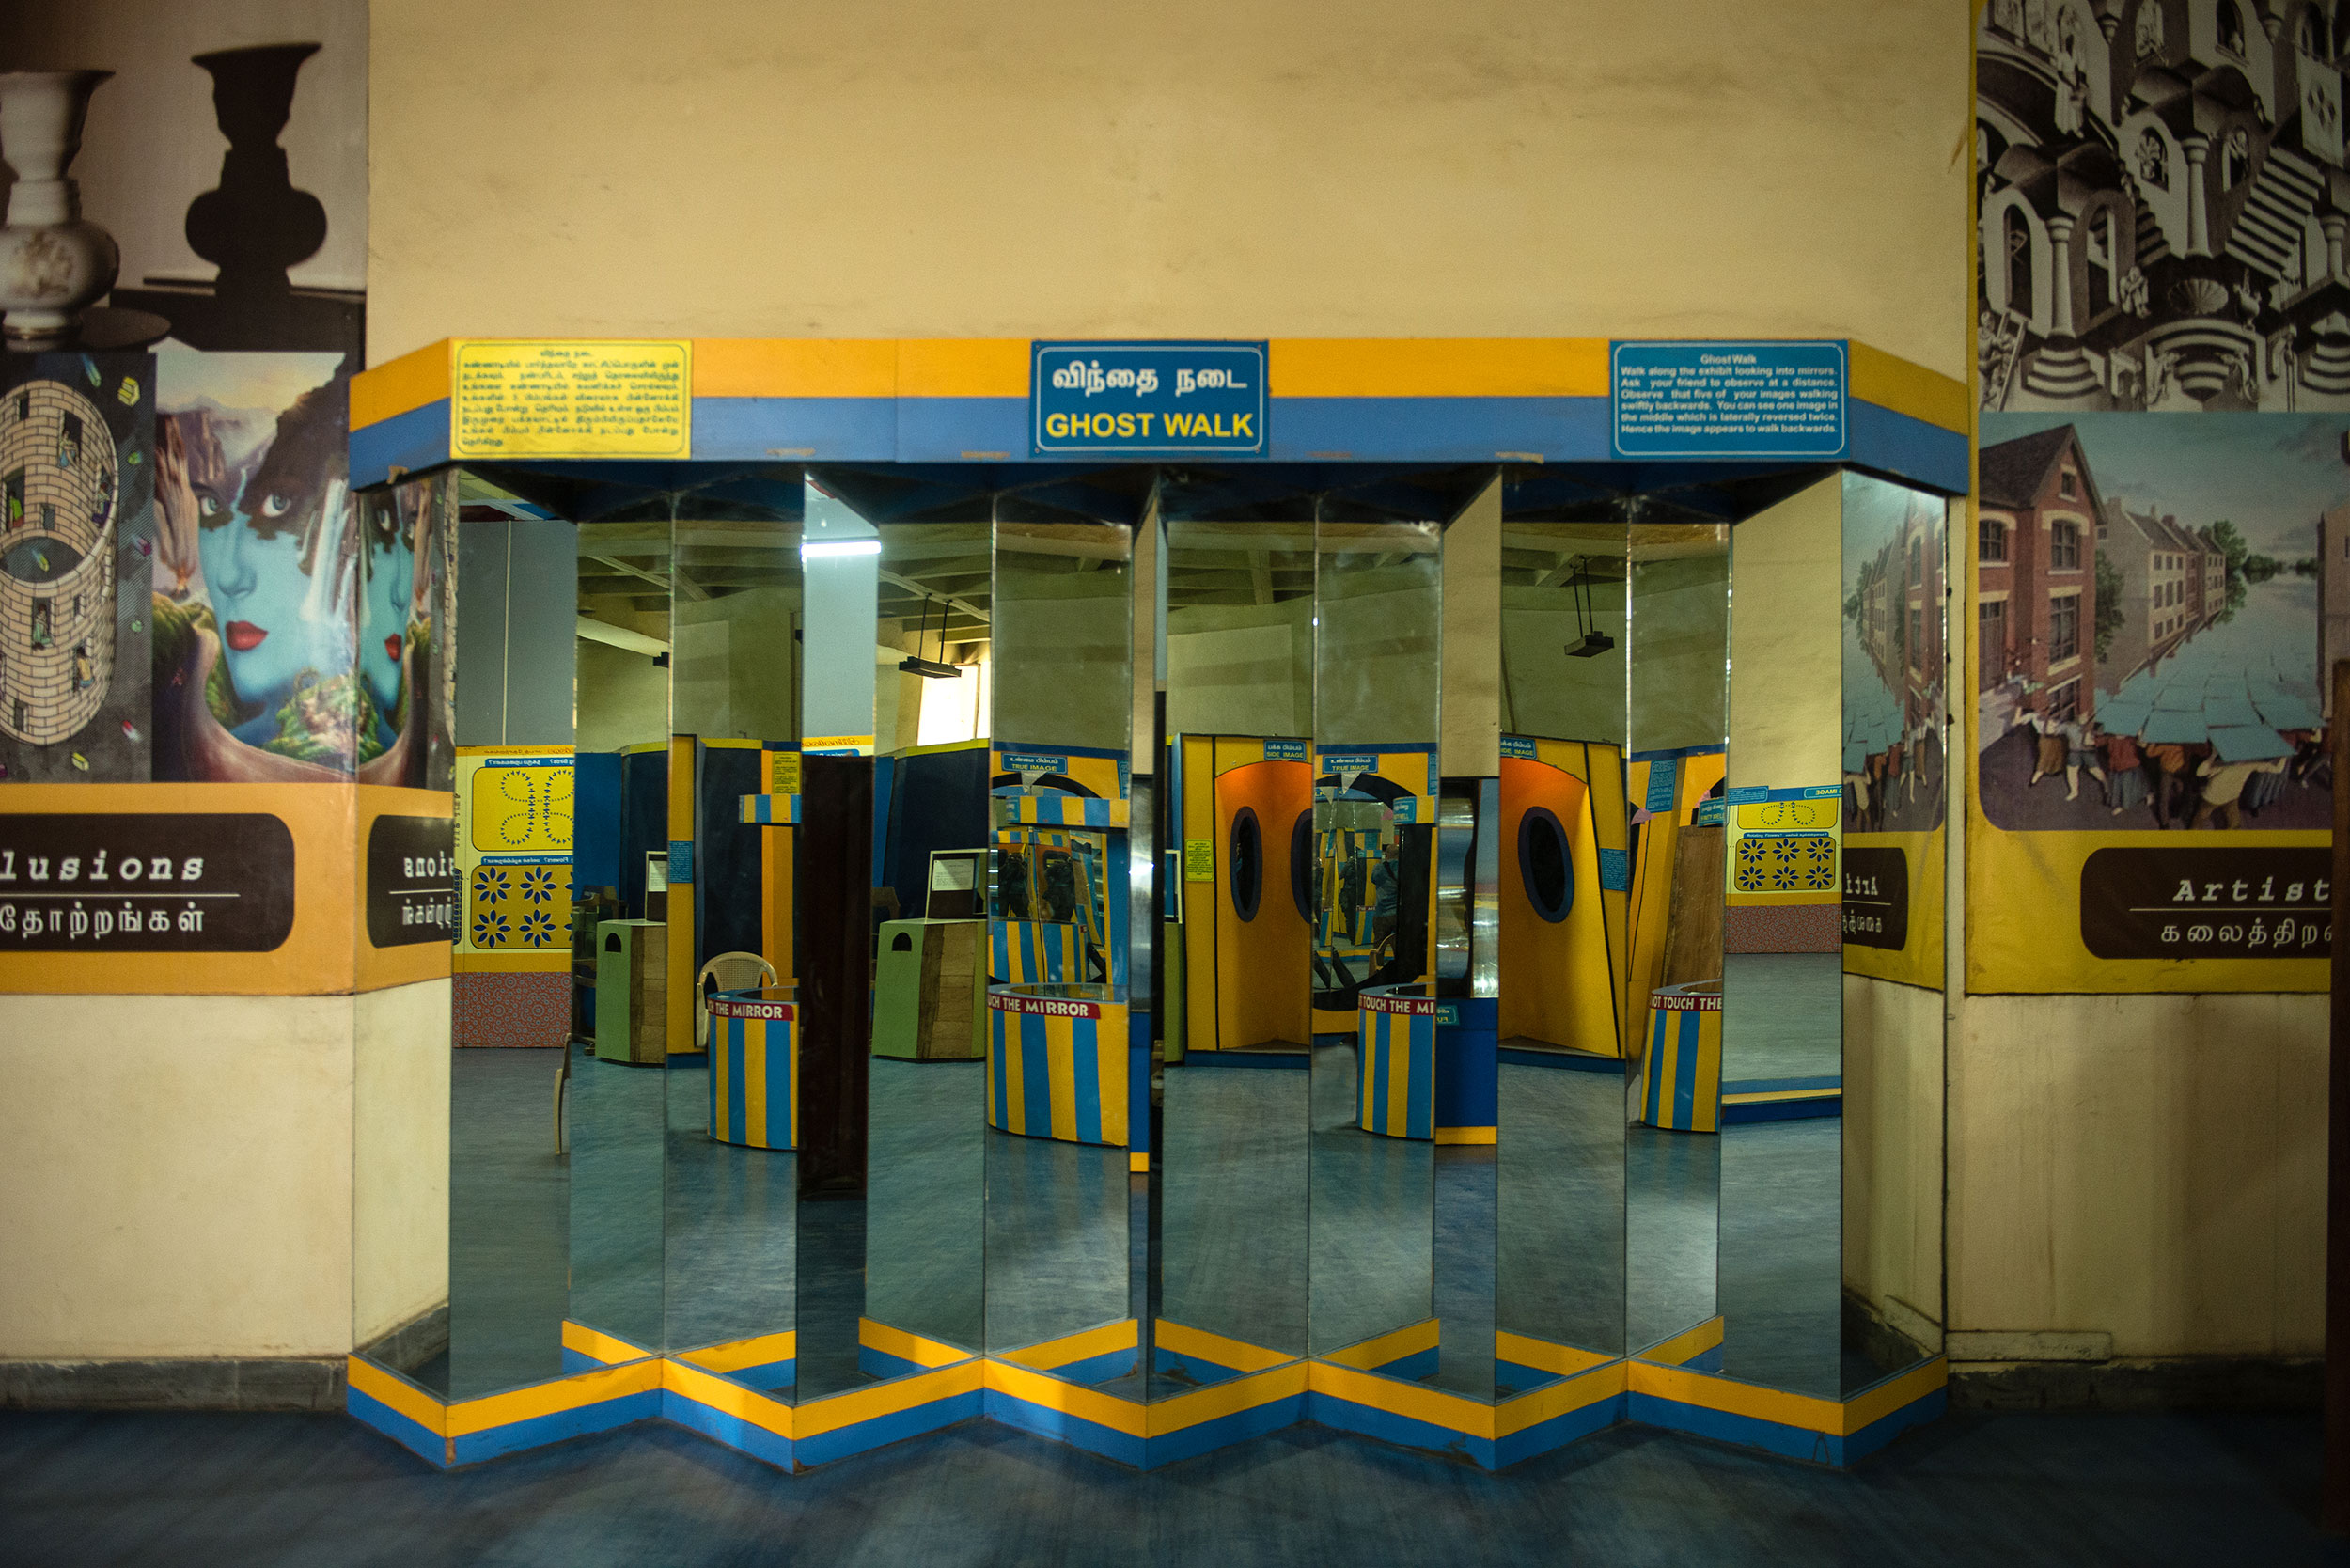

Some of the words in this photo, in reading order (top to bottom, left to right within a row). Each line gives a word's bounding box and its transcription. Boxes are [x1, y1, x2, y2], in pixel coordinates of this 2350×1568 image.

[1700, 354, 1731, 364] Ghost
[1732, 354, 1757, 364] Walk
[1053, 360, 1158, 397] விந்தை
[1175, 368, 1247, 397] நடை
[1622, 367, 1645, 377] Walk
[1649, 367, 1677, 377] along
[1679, 367, 1696, 377] the
[1699, 367, 1732, 377] exhibit
[1735, 367, 1773, 377] looking
[1776, 367, 1794, 377] into
[1798, 367, 1838, 377] mirrors.
[1622, 378, 1640, 388] Ask
[1651, 378, 1672, 388] your
[1677, 378, 1706, 388] friend
[1710, 378, 1720, 388] to
[1724, 378, 1764, 388] observe
[1769, 378, 1778, 388] at
[1793, 378, 1838, 388] distance.
[1622, 389, 1664, 400] Observe
[1671, 389, 1690, 400] that
[1694, 389, 1713, 400] five
[1716, 389, 1727, 400] of
[1734, 389, 1756, 400] your
[1760, 389, 1795, 400] images
[1799, 389, 1838, 400] walking
[1622, 401, 1654, 411] swiftly
[1655, 401, 1712, 411] backwards.
[1717, 401, 1735, 411] You
[1737, 401, 1756, 411] can
[1758, 401, 1775, 411] see
[1776, 401, 1795, 411] one
[1796, 401, 1826, 411] image
[1828, 401, 1838, 411] in
[1622, 413, 1637, 423] the
[1640, 413, 1674, 423] middle
[1677, 413, 1706, 423] which
[1709, 413, 1717, 423] is
[1720, 413, 1760, 423] laterally
[1762, 413, 1806, 423] reversed
[1046, 413, 1154, 438] GHOST
[1163, 413, 1254, 438] WALK
[1622, 424, 1653, 435] Hence
[1654, 424, 1668, 435] the
[1671, 424, 1701, 435] image
[1704, 424, 1744, 435] appears
[1746, 424, 1755, 435] to
[1758, 424, 1779, 435] walk
[1781, 424, 1838, 435] backwards.
[0, 849, 204, 881] lusions
[2172, 876, 2330, 902] Artist
[1002, 998, 1021, 1011] THE
[1025, 1000, 1089, 1017] MIRROR
[1363, 996, 1386, 1011] TOUCH
[1389, 1000, 1410, 1013] THE
[1416, 1002, 1434, 1014] MI
[1663, 996, 1695, 1010] TOUCH
[1700, 998, 1722, 1010] THE
[715, 1002, 729, 1015] THE
[732, 1004, 783, 1019] MIRROR
